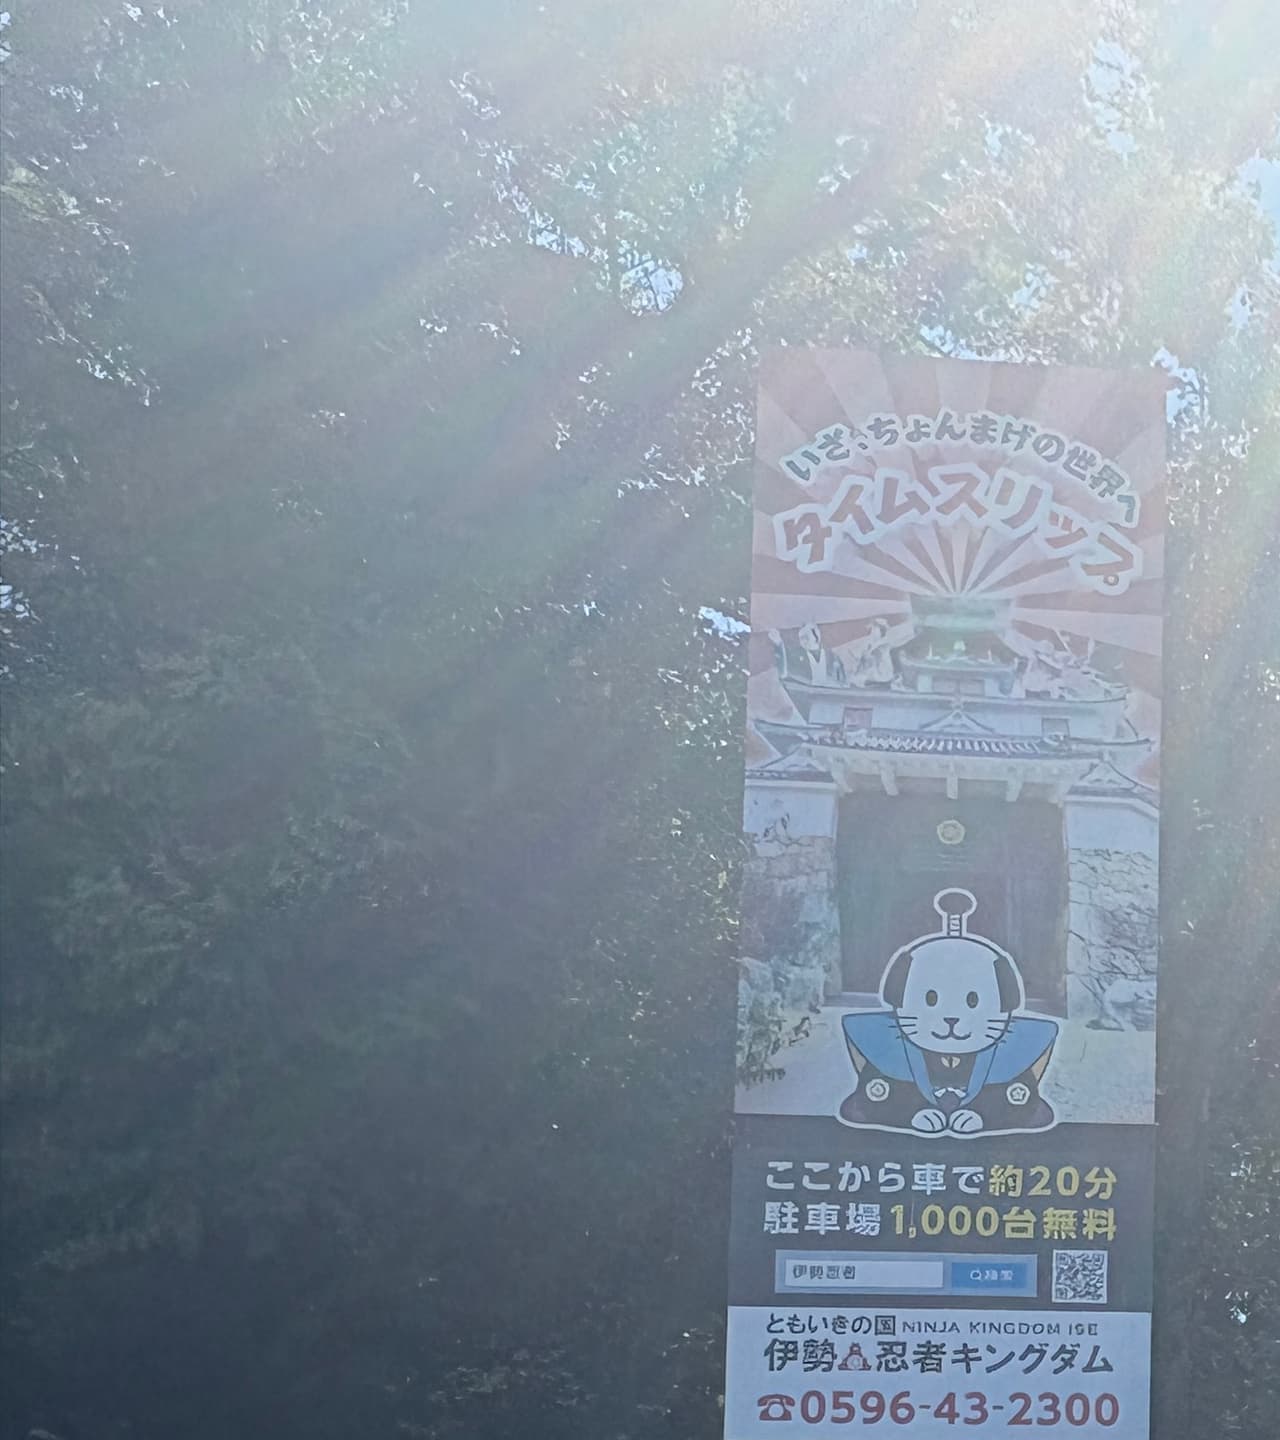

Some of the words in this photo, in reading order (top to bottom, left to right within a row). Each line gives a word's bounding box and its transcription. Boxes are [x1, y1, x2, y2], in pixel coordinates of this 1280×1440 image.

[902, 1321, 960, 1334] NINJA
[969, 1321, 1061, 1335] KINGDOM
[800, 1390, 1120, 1427] 0596-43-2300
